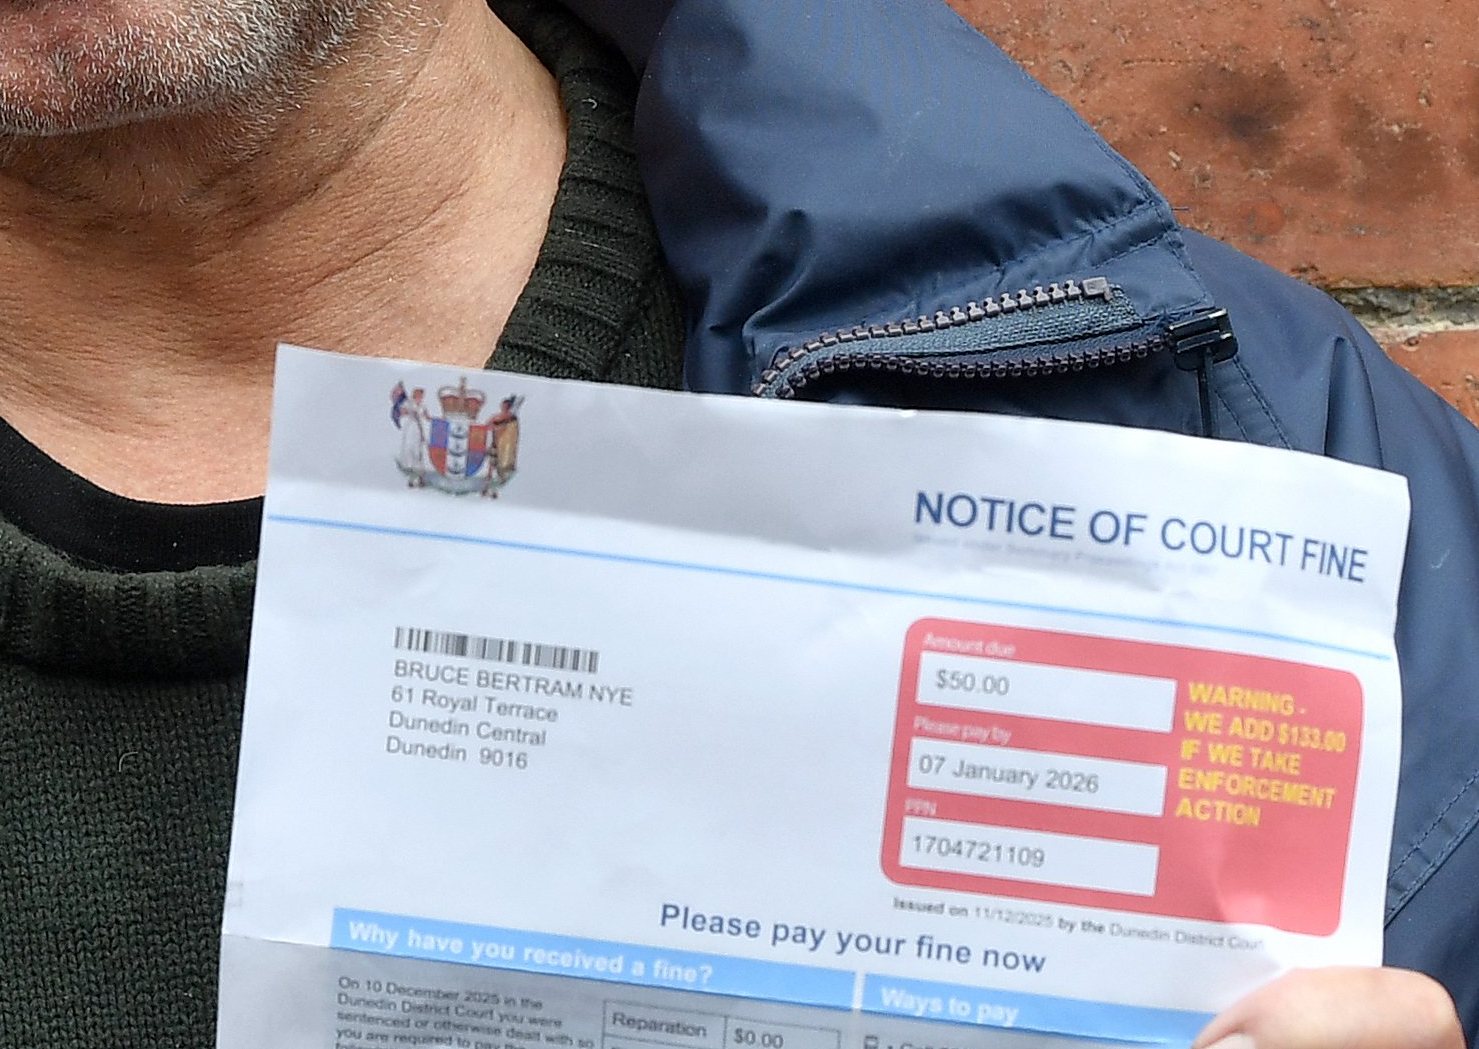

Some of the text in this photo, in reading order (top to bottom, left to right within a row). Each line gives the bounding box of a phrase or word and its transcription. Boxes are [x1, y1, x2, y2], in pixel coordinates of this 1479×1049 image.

[914, 490, 1077, 541] NOTICE
[1089, 509, 1148, 547] OF
[1161, 517, 1294, 568] COURT
[1300, 537, 1369, 583] FINE
[923, 632, 1018, 656] Amount due
[394, 658, 634, 707] BRUCE BERTRAM NYE
[936, 668, 1011, 696] $50.00
[1189, 682, 1295, 716] WARNING
[391, 685, 558, 723] 61 Royal Terrace
[388, 709, 547, 747] Dunedin Central
[914, 715, 1012, 746] Please pay by
[1185, 711, 1223, 735] WE
[1230, 716, 1275, 742] ADD
[385, 735, 529, 770] Dunedin 9016
[1181, 739, 1301, 776] IF WE TAKE
[920, 754, 1099, 794] 07 January 2026
[1178, 767, 1336, 810] ENFORCEMENT
[1176, 797, 1262, 827] ACTION
[914, 835, 1046, 868] 1704721109
[661, 903, 1047, 975] Please pay your fine now
[893, 897, 945, 916] Issued
[949, 905, 968, 917] on
[975, 906, 1054, 929] 11/12/2025
[1057, 916, 1076, 934] by
[1081, 920, 1103, 934] the
[1109, 923, 1170, 941] Dunedin
[1175, 929, 1224, 946] District
[348, 920, 714, 985] Why have you received a fine?
[338, 976, 543, 1010] On 10 December 2025 in the
[338, 992, 563, 1029] Dunedin District Court you were
[880, 987, 1020, 1029] Ways to pay
[336, 1028, 362, 1040] you
[366, 1033, 388, 1043] are
[337, 1011, 410, 1029] sentenced
[415, 1019, 429, 1029] or
[433, 1020, 502, 1037] otherwise
[612, 1012, 784, 1049] Reparation $0.00
